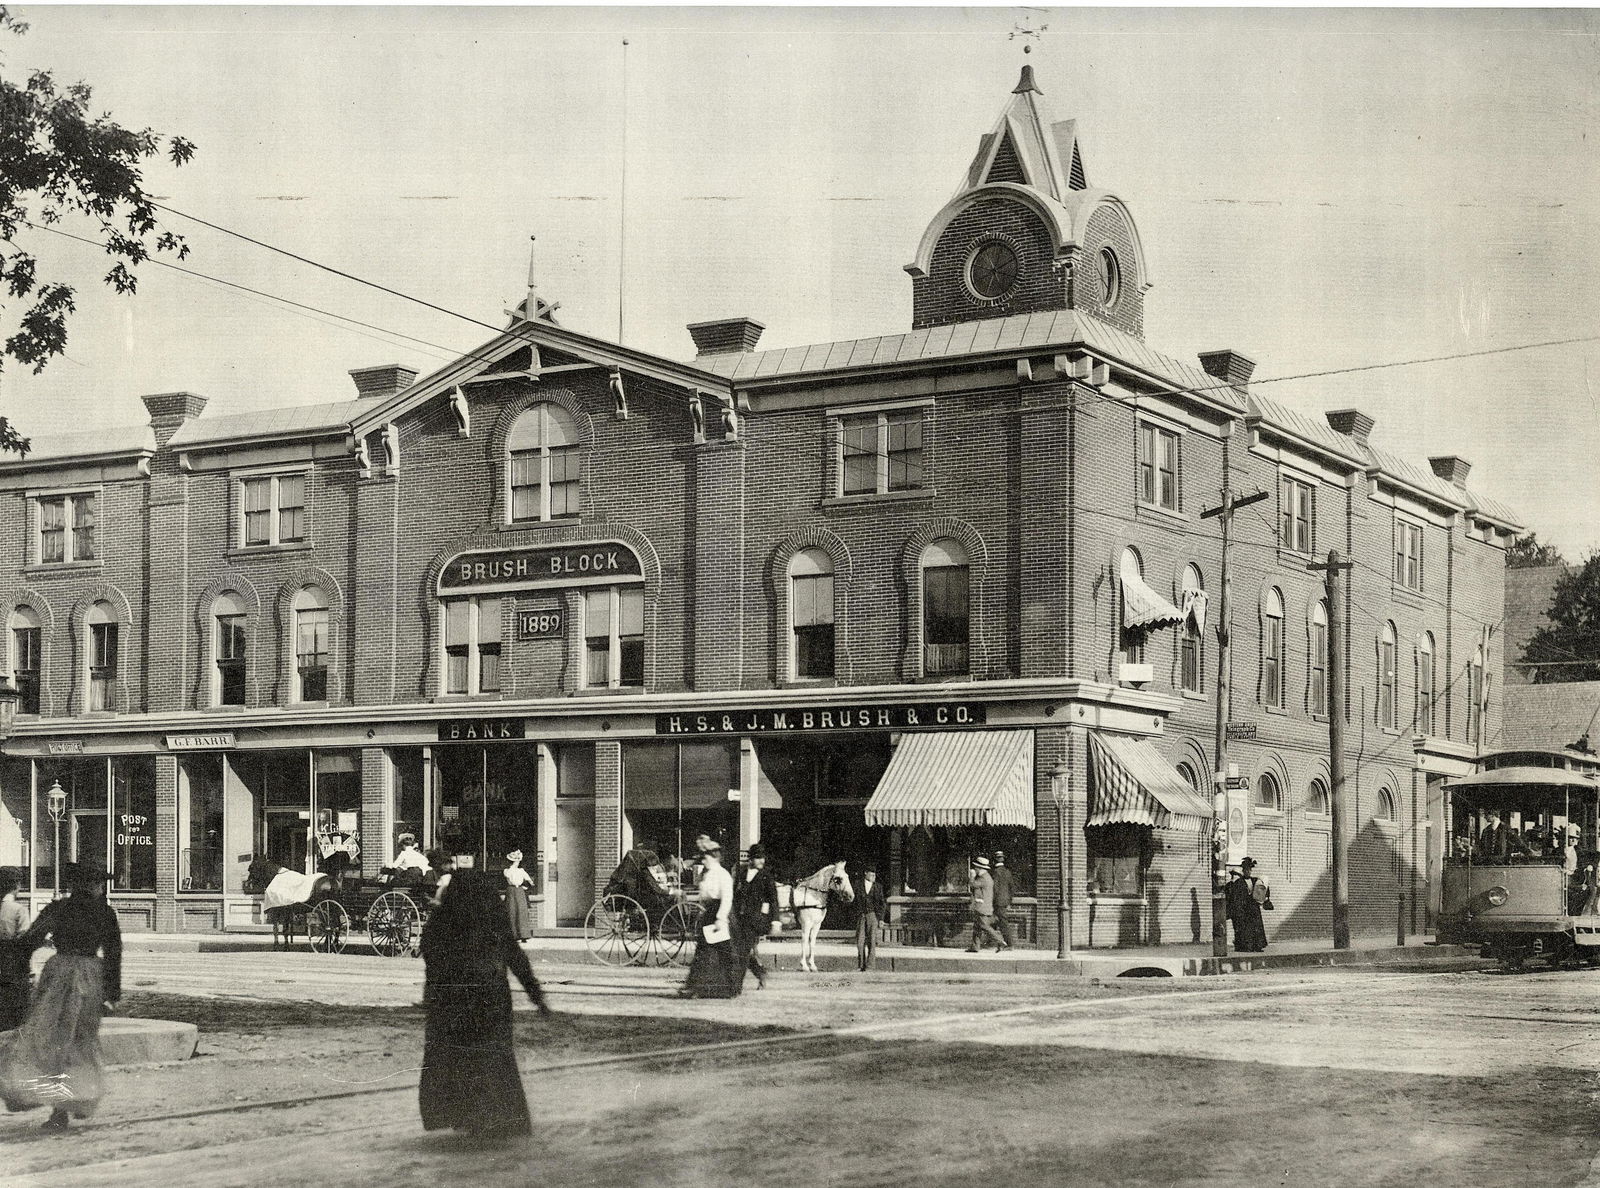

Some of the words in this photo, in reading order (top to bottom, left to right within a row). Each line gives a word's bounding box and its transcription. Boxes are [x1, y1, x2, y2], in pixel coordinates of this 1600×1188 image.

[462, 559, 528, 580] BRUSH
[550, 552, 619, 574] BLOCK
[521, 614, 560, 634] 1889
[722, 715, 734, 731] &
[803, 709, 891, 728] BRUSH
[908, 708, 919, 724] &
[937, 706, 974, 723] CO.
[451, 723, 511, 739] BANK
